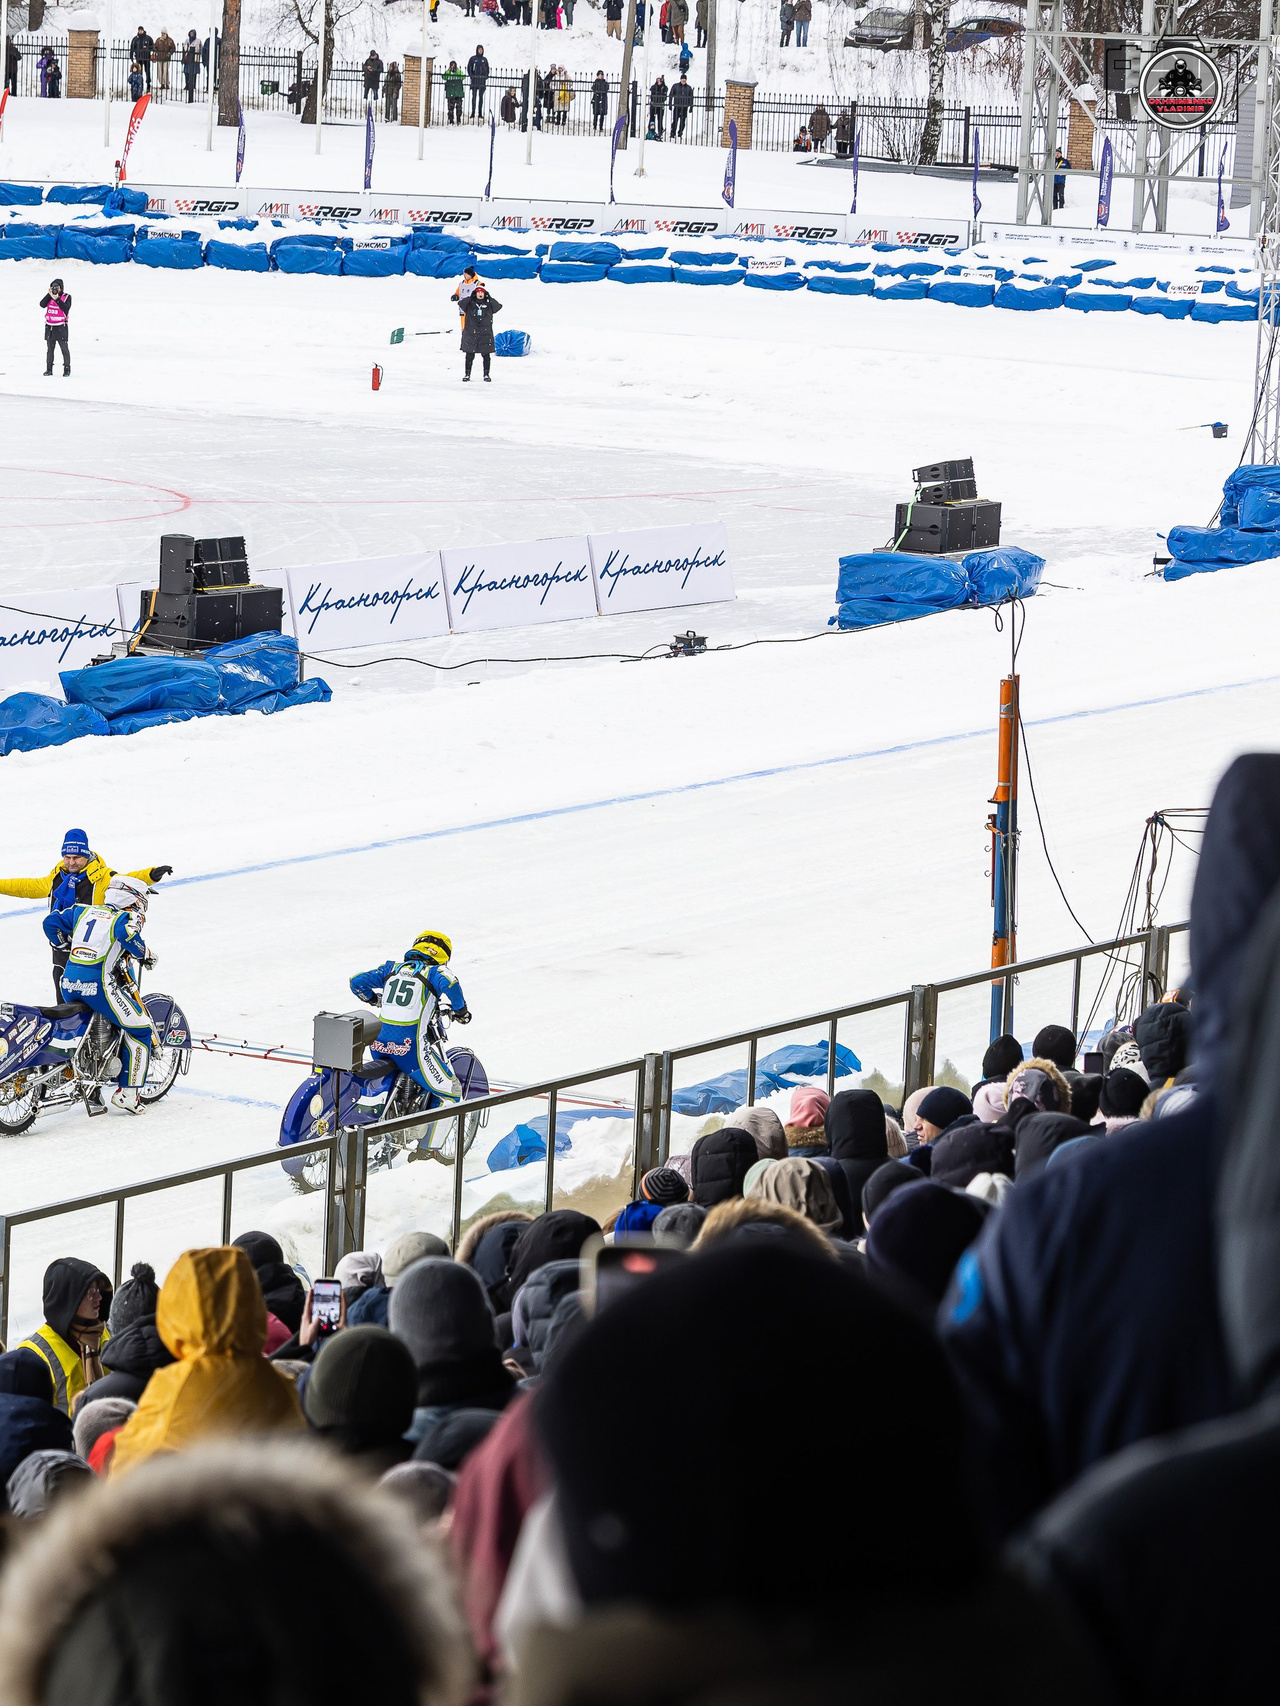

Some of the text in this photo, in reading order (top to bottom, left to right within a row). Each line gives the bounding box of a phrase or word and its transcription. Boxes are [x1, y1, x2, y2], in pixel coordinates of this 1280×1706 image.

[193, 200, 239, 213] RGP
[317, 206, 362, 218] RGP
[427, 211, 472, 223] RGP
[548, 217, 595, 230] RGP
[673, 221, 718, 233] RGP
[791, 226, 837, 239] RGP
[912, 233, 959, 245] RGP
[599, 547, 726, 598] Красногорск
[453, 563, 588, 615] Красногорск
[298, 578, 440, 634] Красногорск
[83, 919, 98, 943] 1
[386, 979, 416, 1007] 15
